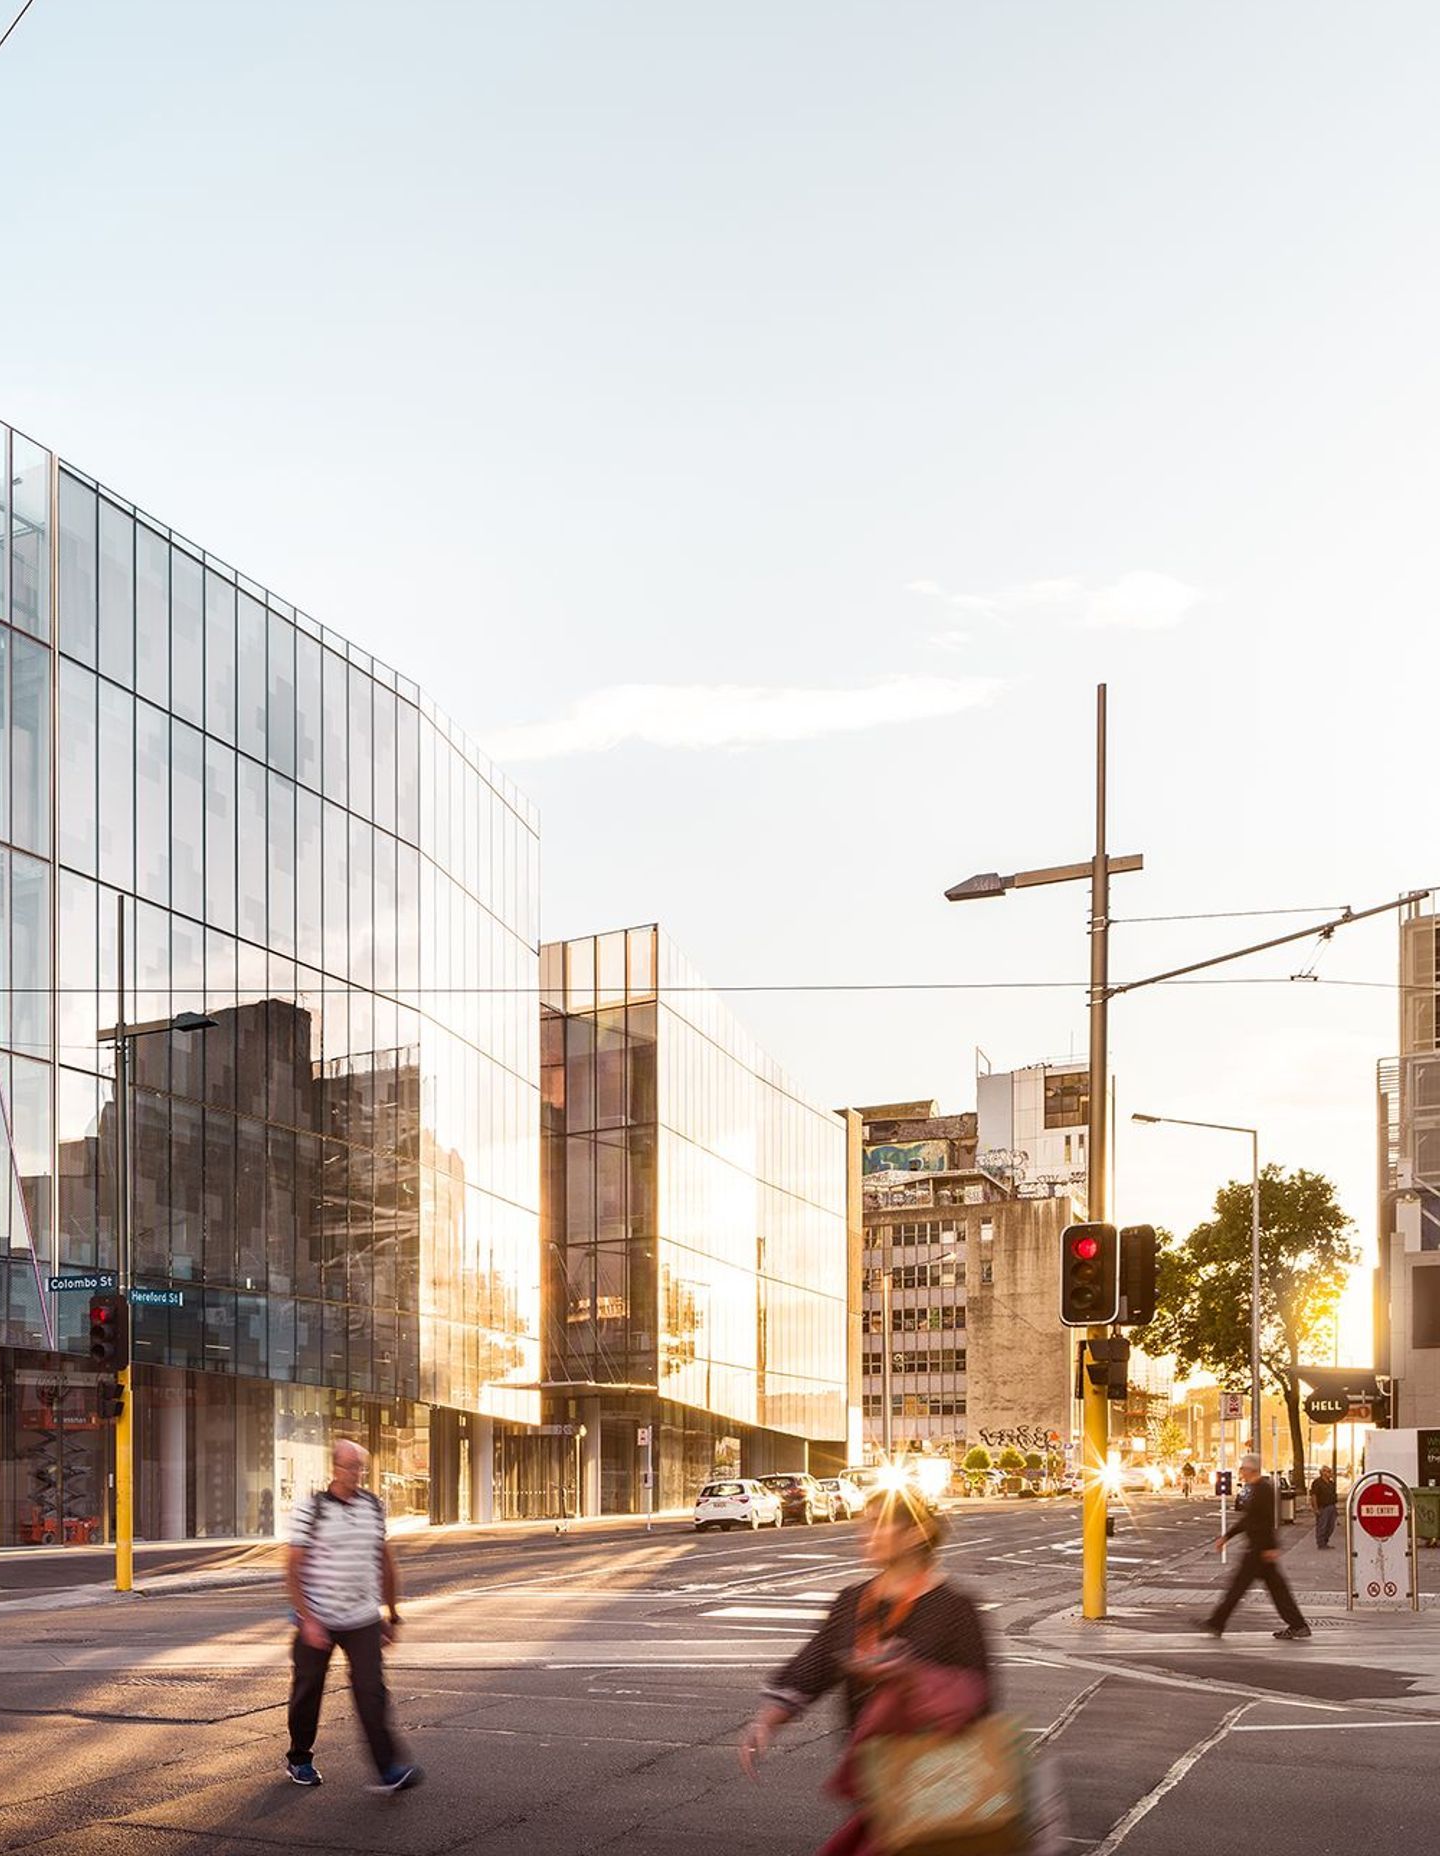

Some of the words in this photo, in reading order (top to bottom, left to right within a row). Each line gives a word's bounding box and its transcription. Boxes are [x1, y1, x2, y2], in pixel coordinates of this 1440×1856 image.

[50, 1278, 98, 1290] Colombo
[100, 1276, 112, 1287] St
[131, 1291, 167, 1303] Hereford
[168, 1292, 177, 1303] St
[1311, 1400, 1342, 1411] HELL
